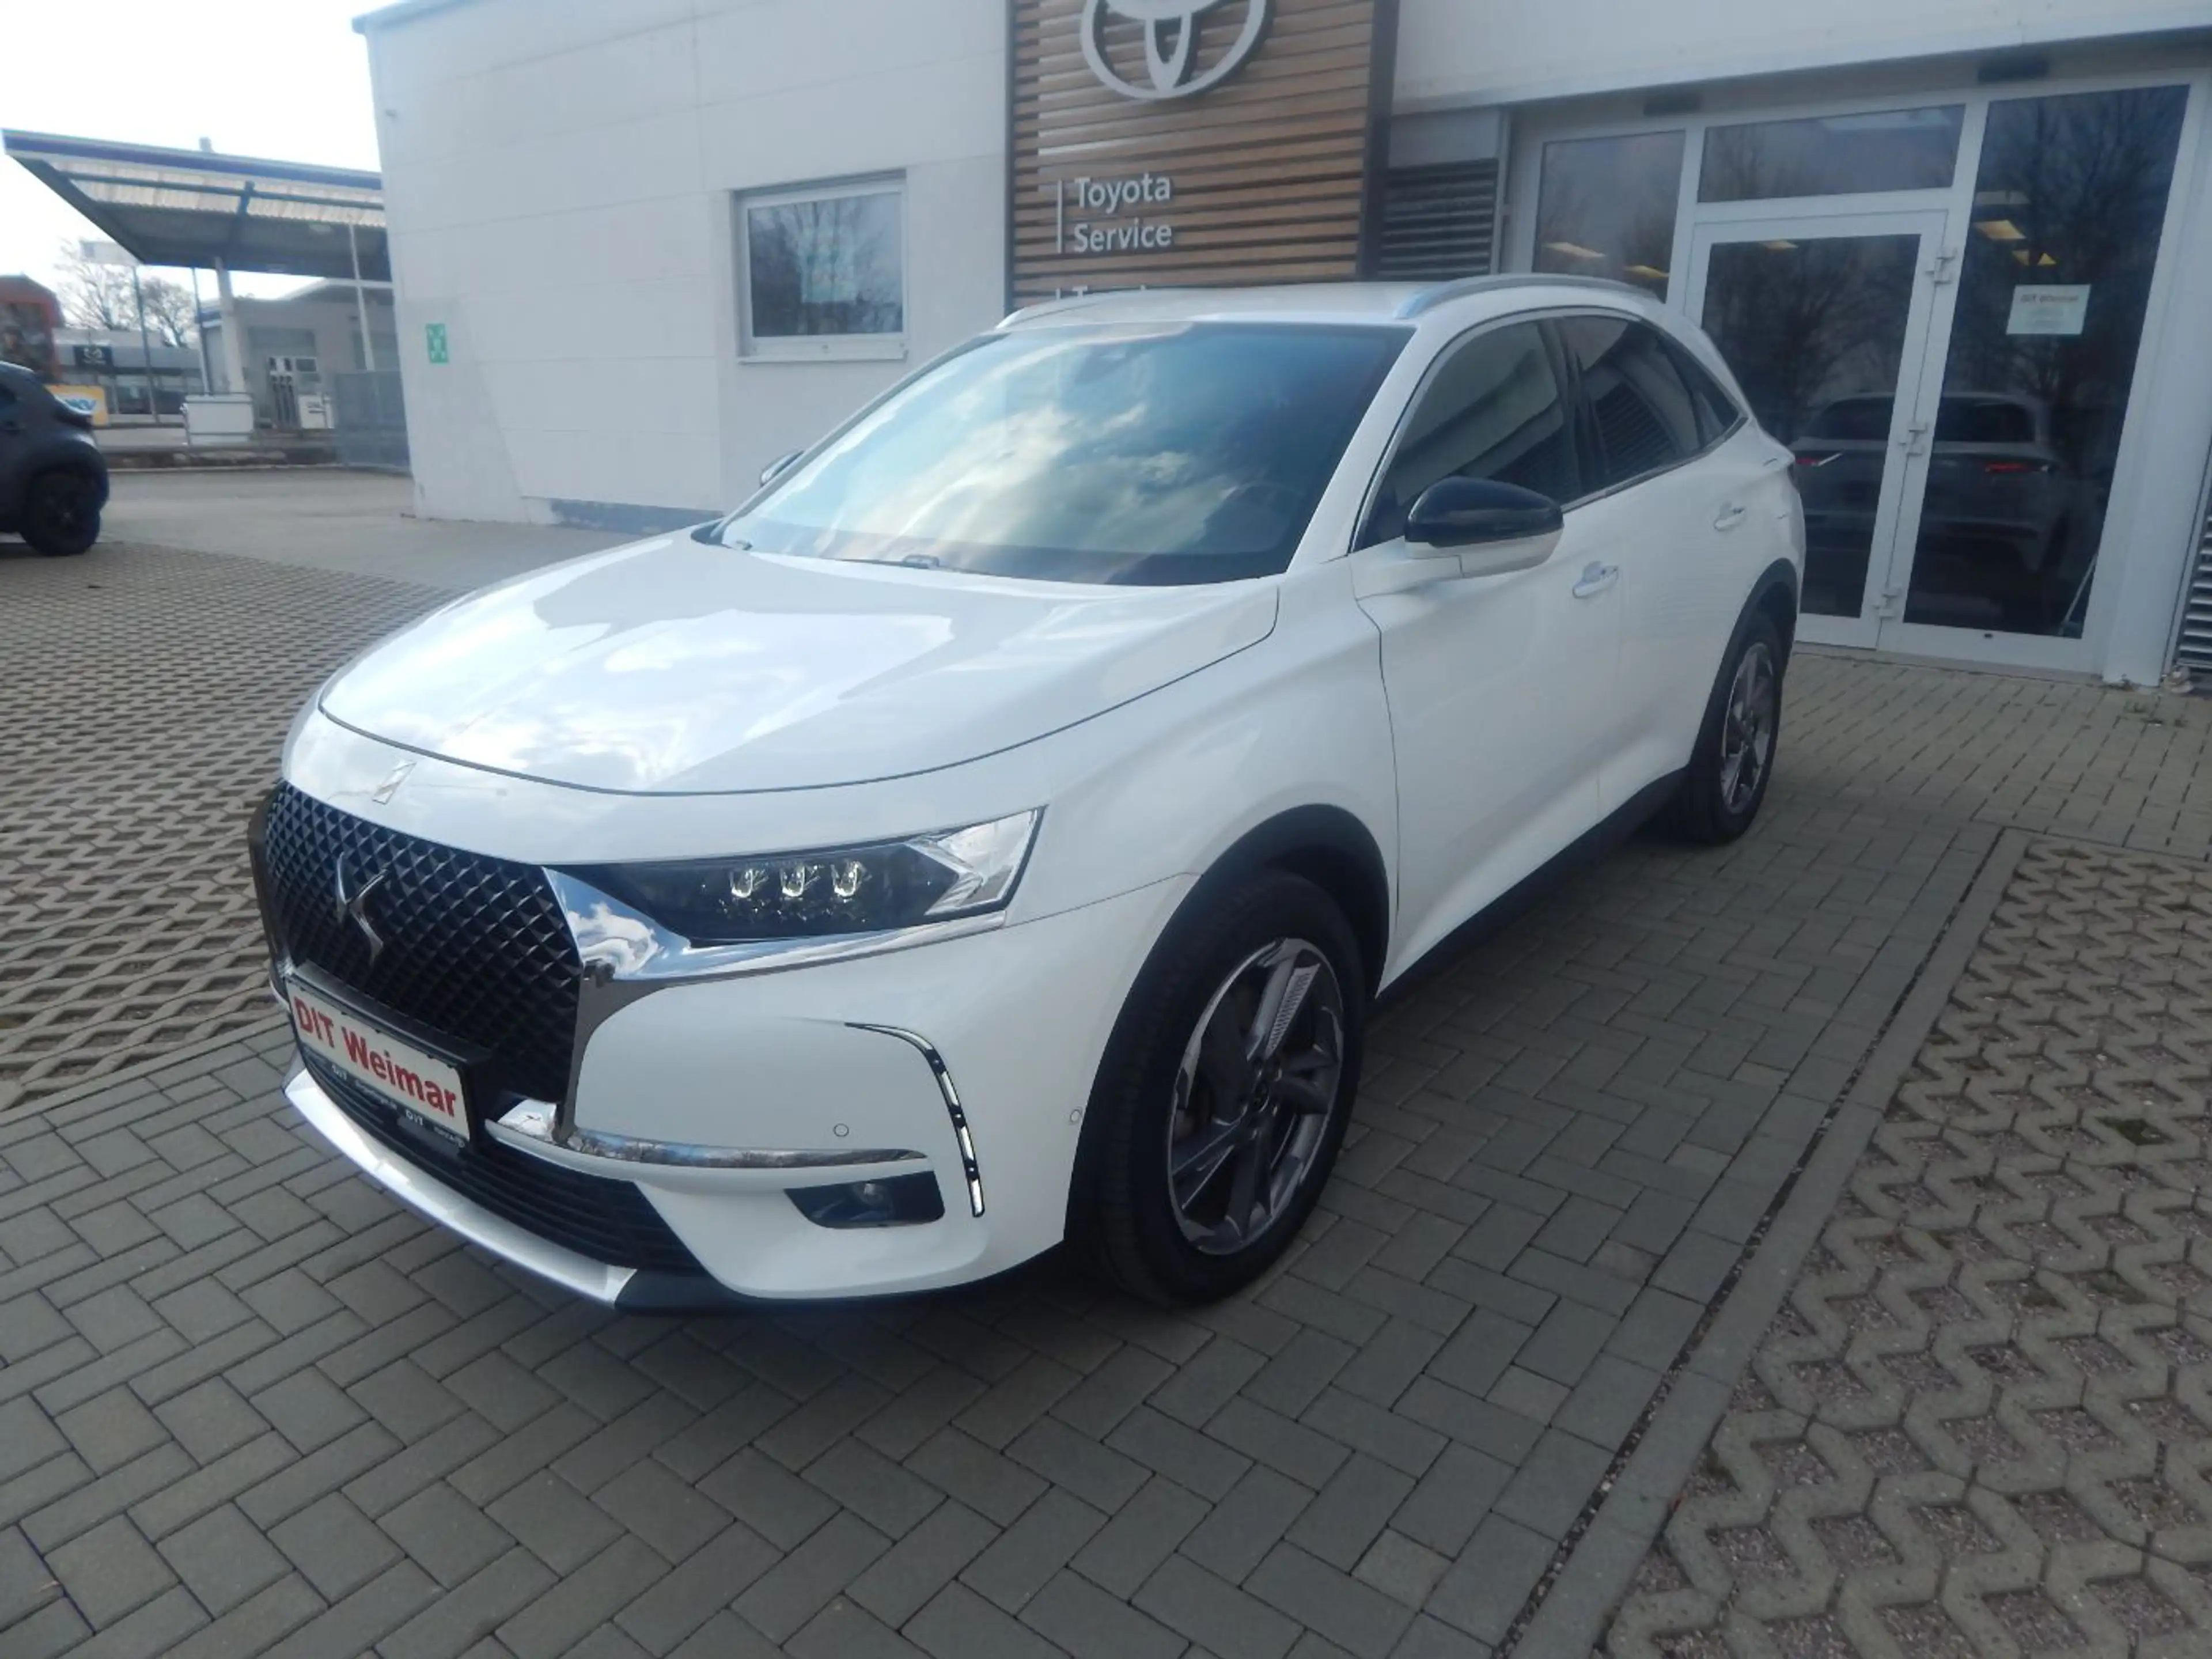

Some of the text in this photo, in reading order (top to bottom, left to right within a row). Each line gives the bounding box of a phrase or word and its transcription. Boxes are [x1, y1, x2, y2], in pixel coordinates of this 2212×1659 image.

[1074, 173, 1171, 213] Toyota
[1074, 218, 1172, 252] Service
[294, 997, 334, 1048] DIT
[342, 1027, 456, 1118] Weimar
